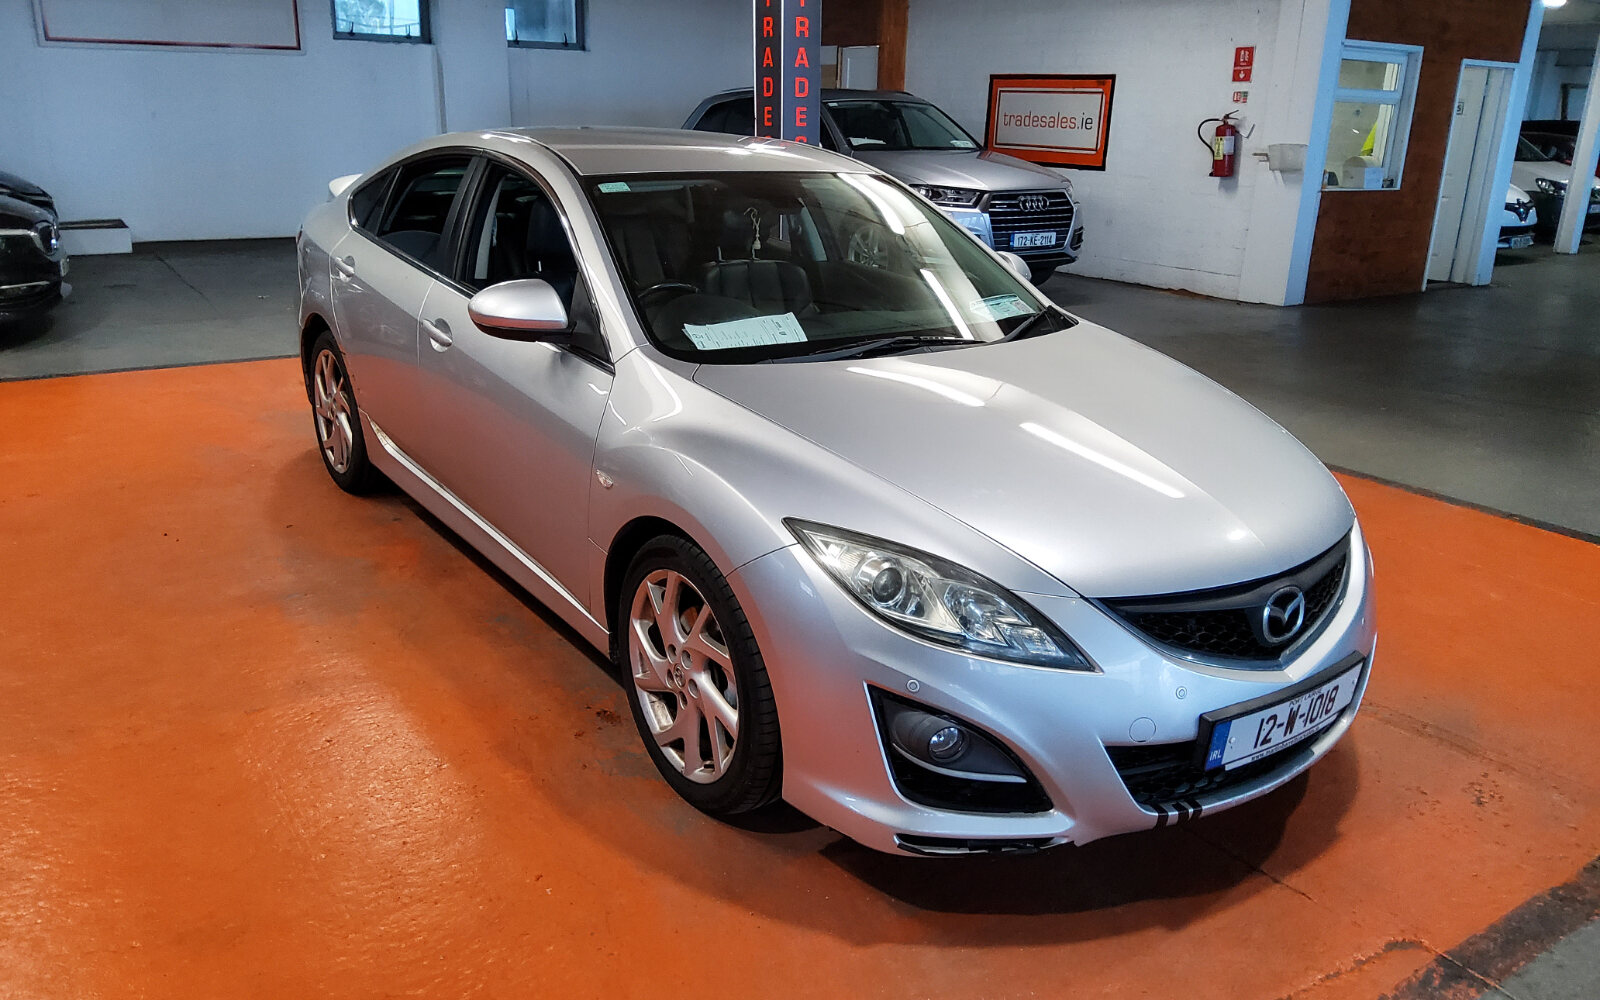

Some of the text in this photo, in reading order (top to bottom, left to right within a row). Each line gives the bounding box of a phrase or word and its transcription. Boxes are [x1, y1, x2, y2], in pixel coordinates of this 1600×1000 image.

[763, 0, 774, 138] RADE
[1003, 110, 1094, 130] tradesales.ie
[1017, 234, 1053, 247] 172-KE-2114
[1253, 684, 1340, 750] 12-W-1018
[1209, 750, 1223, 761] IRL
